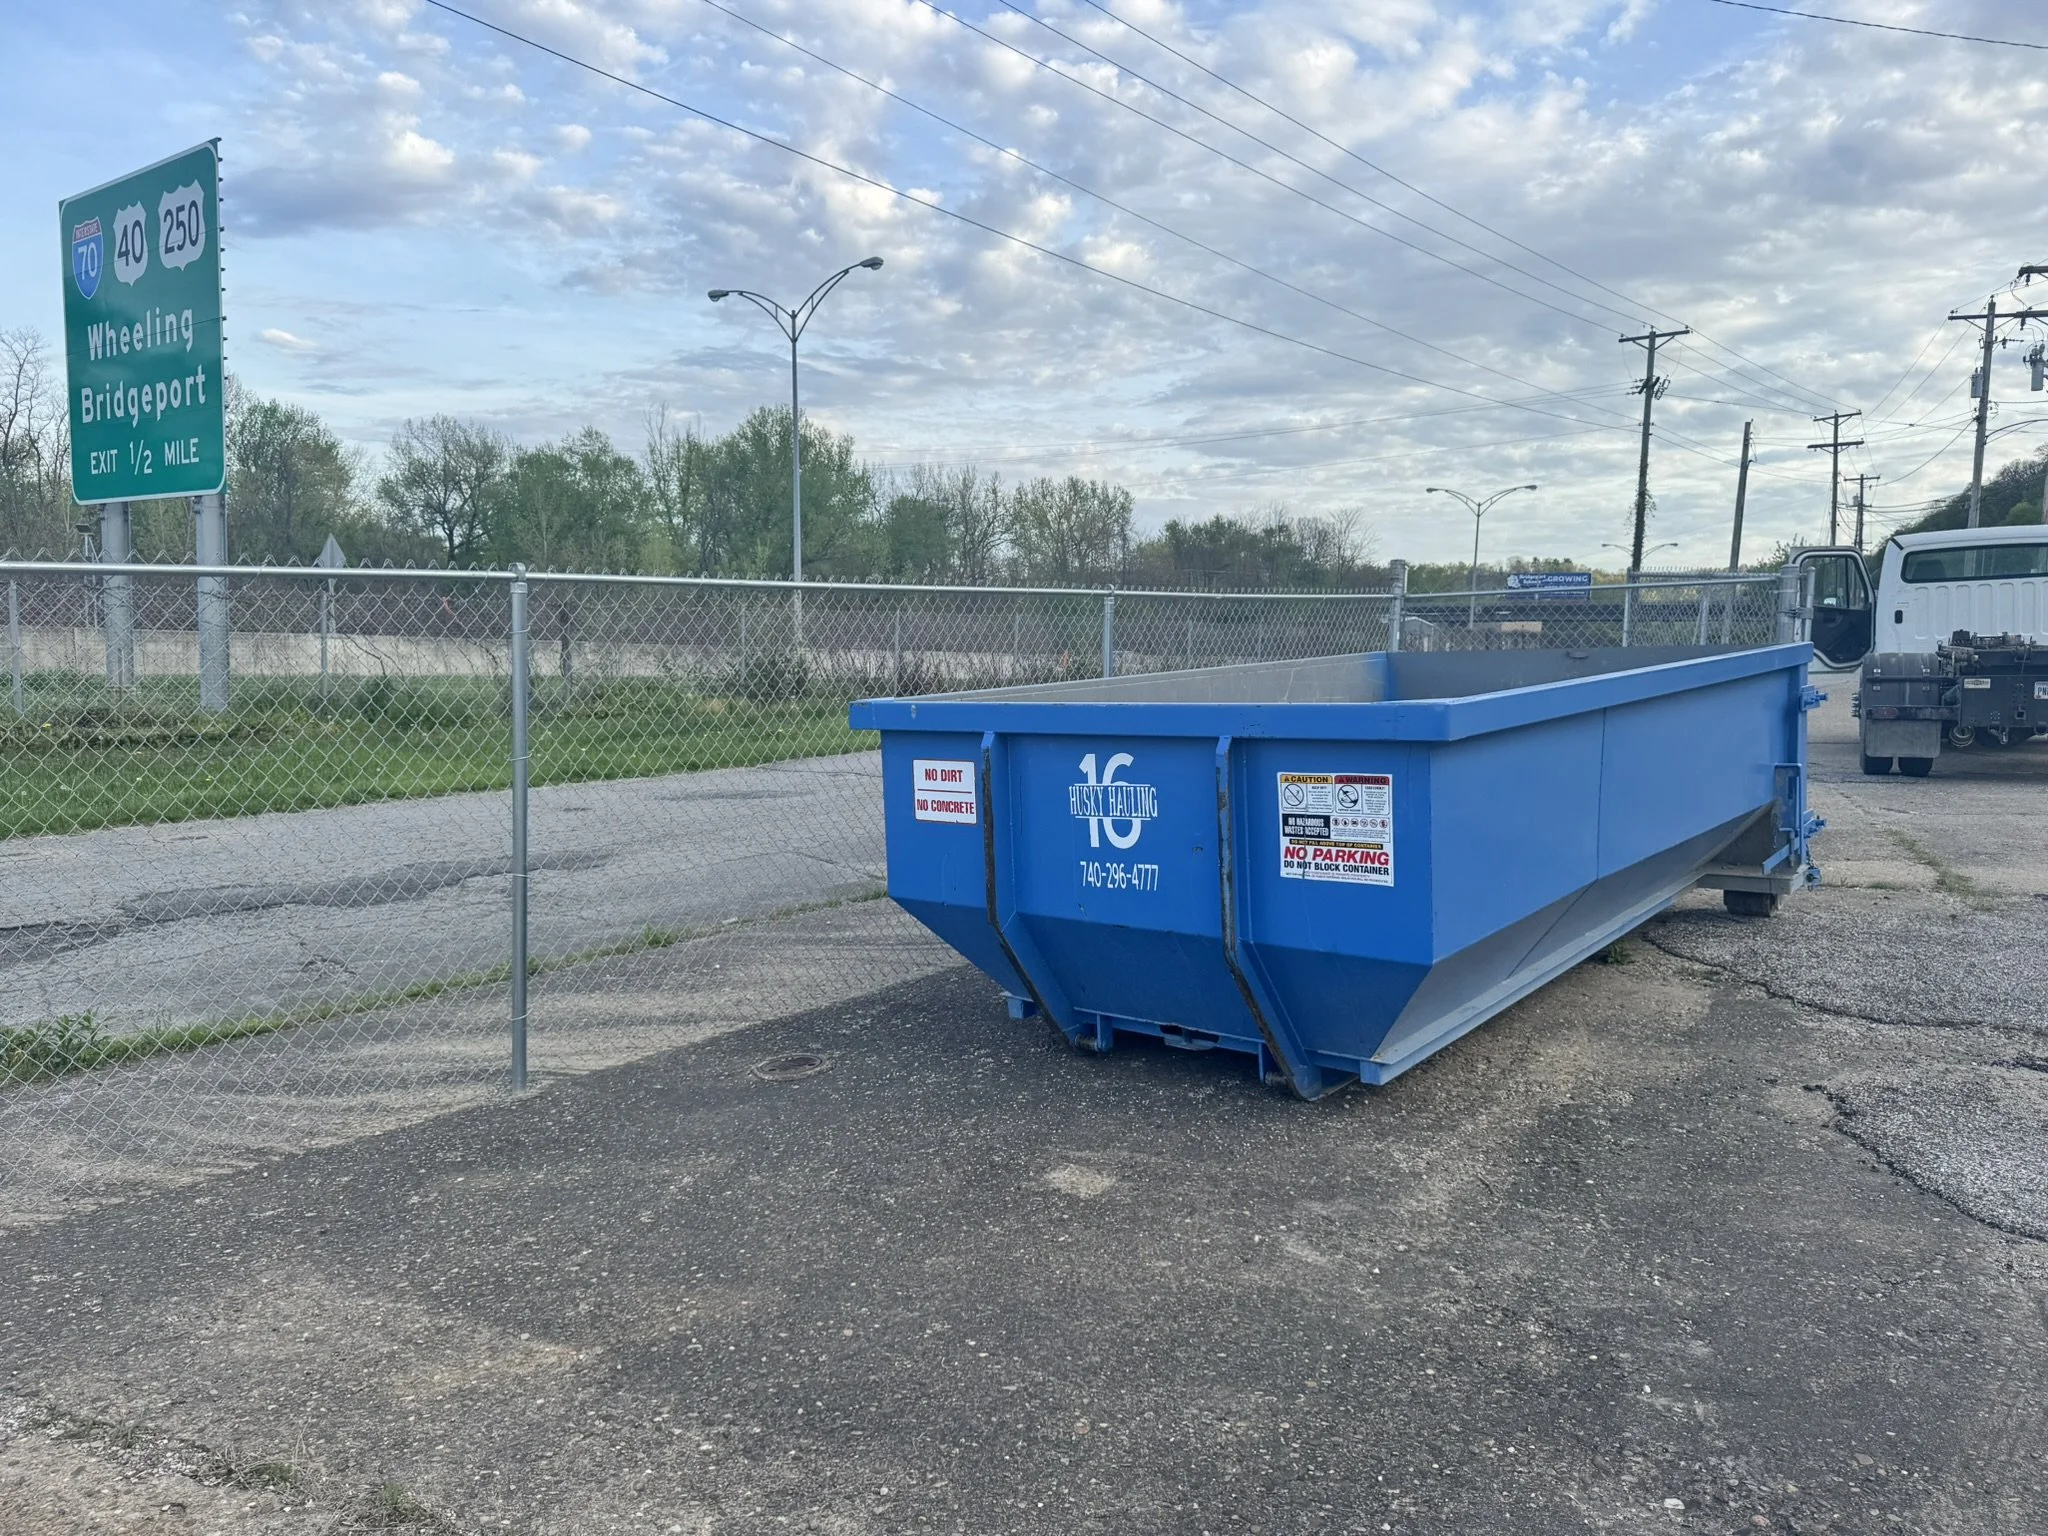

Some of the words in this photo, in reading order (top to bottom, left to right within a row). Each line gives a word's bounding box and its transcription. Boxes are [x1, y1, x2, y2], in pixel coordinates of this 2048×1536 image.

[75, 221, 100, 241] INTERSTATE
[117, 219, 144, 267] 40
[163, 200, 200, 255] 250
[78, 242, 98, 281] 70
[87, 307, 194, 361] Wheeling
[81, 364, 206, 428] Bridgeport
[90, 449, 118, 475] EXIT
[129, 439, 153, 475] 1/2
[164, 437, 199, 466] MILE
[925, 768, 938, 781] NO
[941, 768, 963, 783] DIRT
[1346, 776, 1387, 784] WARNING
[917, 798, 928, 811] NO
[931, 799, 974, 814] CONCRETE
[1069, 786, 1103, 816] HUSKY
[1108, 786, 1158, 817] HAULING
[1079, 753, 1142, 849] 16
[1284, 846, 1308, 860] NO
[1312, 847, 1390, 866] PARKING
[1284, 860, 1294, 868] DO
[1296, 860, 1312, 870] NOT
[1314, 861, 1341, 872] BLOCK
[1342, 864, 1389, 876] CONTAINER
[1080, 861, 1158, 891] 740-296-4777
